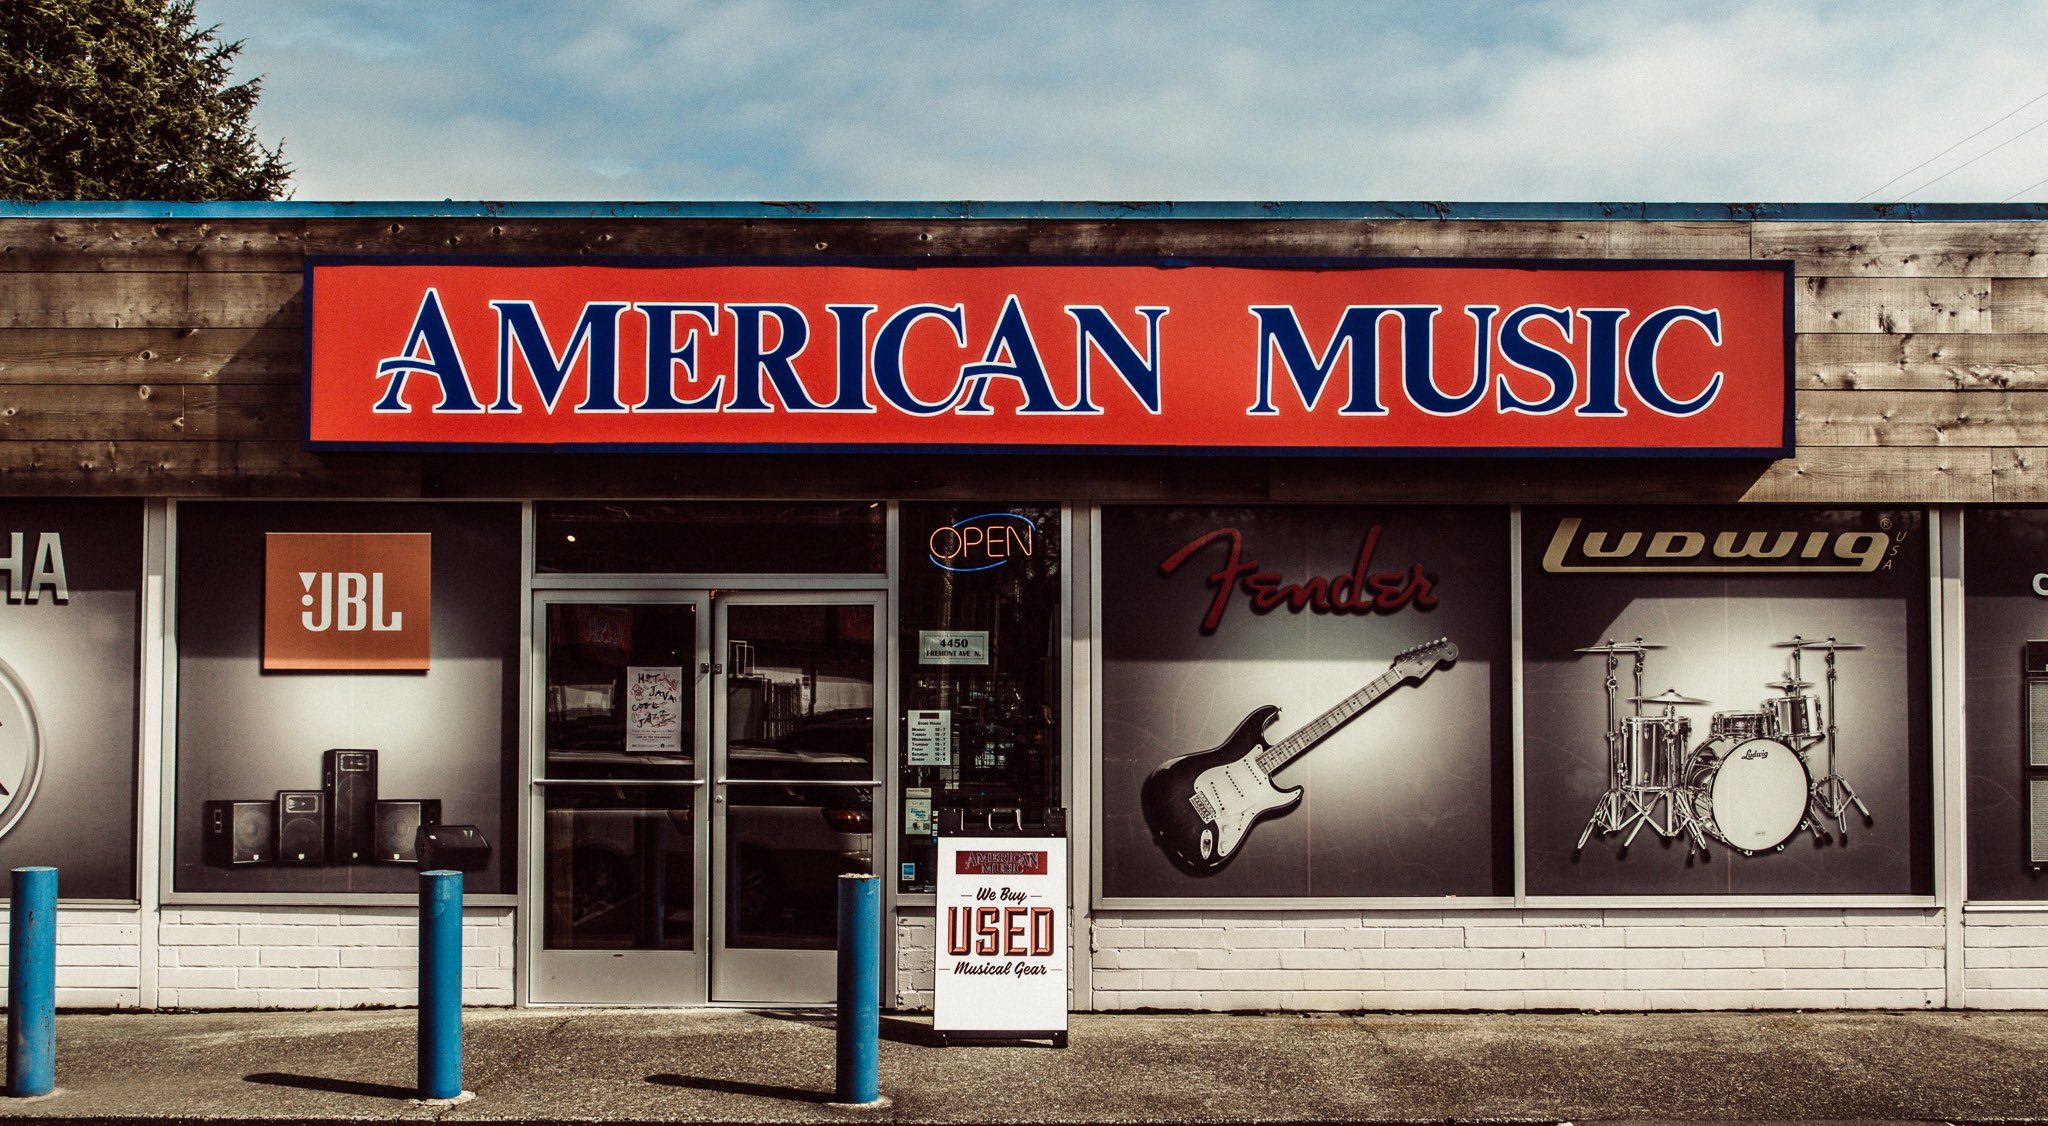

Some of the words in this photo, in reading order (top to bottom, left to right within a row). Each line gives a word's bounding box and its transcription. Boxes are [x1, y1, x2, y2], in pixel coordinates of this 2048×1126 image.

[373, 287, 1170, 417] AMERICAN
[1246, 304, 1724, 418] MUSIC
[929, 525, 1033, 559] OPEN
[1159, 525, 1441, 636] Fender
[299, 572, 403, 632] JBL
[940, 638, 969, 648] 4450
[637, 672, 660, 684] HOT
[1741, 749, 1769, 761] Ludwig
[965, 852, 1039, 870] AMERICAN
[981, 863, 1024, 874] MUSIC
[976, 887, 997, 900] We
[1000, 887, 1027, 905] Buy
[947, 906, 1055, 956] USED
[954, 961, 1012, 976] Musical
[1014, 961, 1047, 978] Gear
